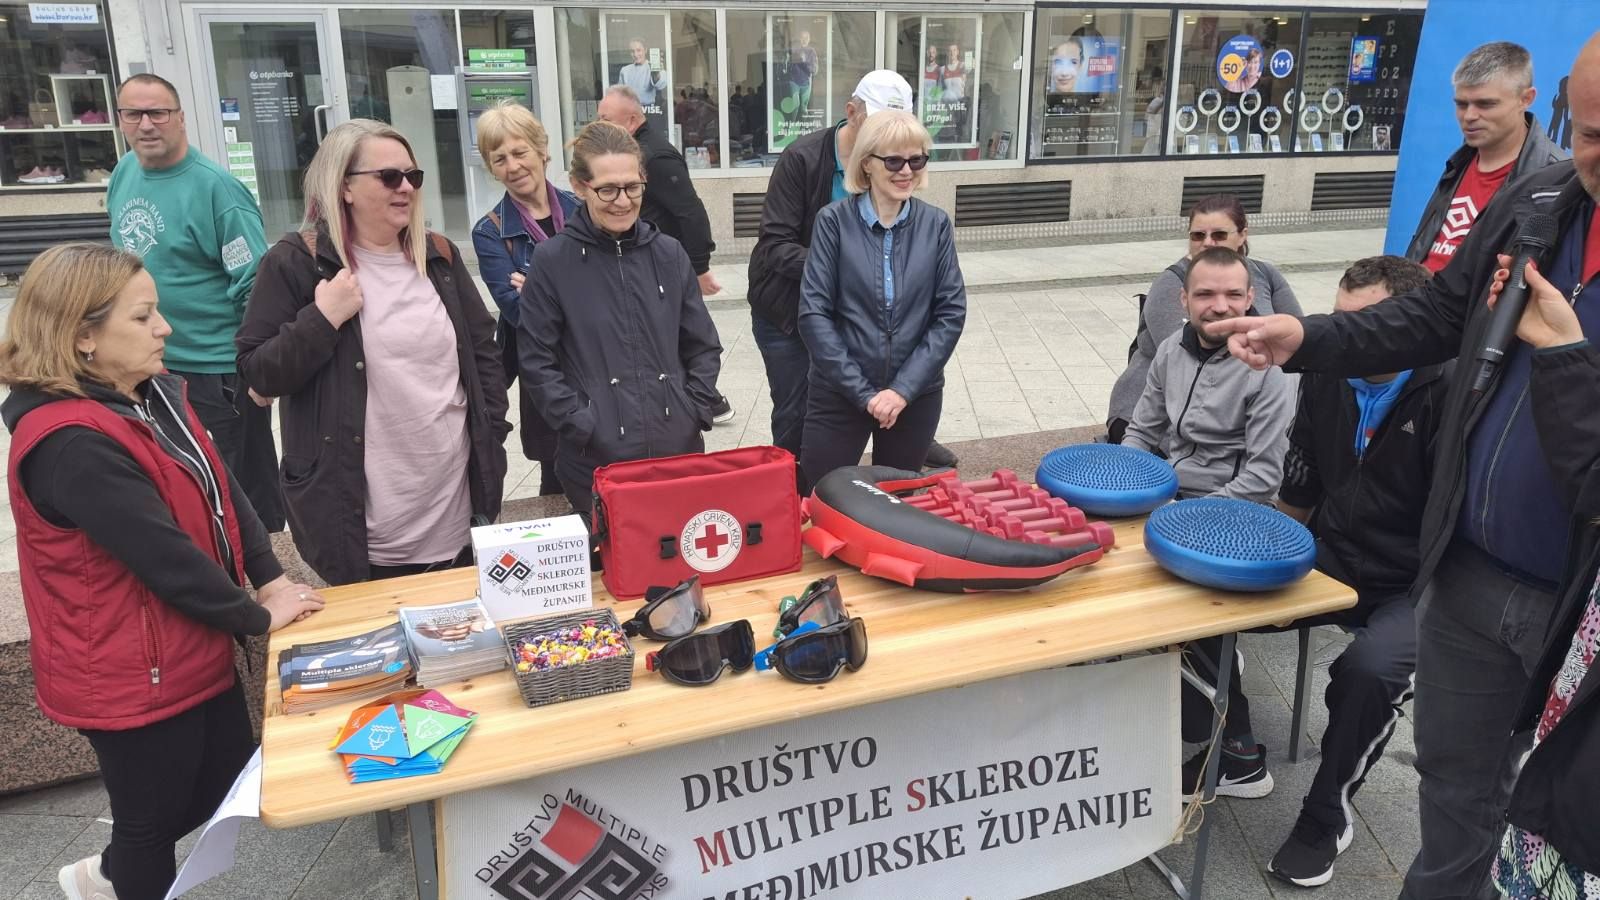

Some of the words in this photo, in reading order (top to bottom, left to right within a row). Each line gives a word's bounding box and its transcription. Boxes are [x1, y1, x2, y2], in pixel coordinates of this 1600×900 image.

[1273, 58, 1291, 69] 1+1
[259, 70, 294, 80] otpbanka
[641, 104, 663, 114] VIŠE,
[948, 101, 967, 111] VIŠE,
[149, 204, 166, 233] BAND
[683, 517, 702, 558] HRVATSKI
[703, 512, 735, 528] CRVENI
[537, 539, 584, 553] DRUŠTVO
[538, 553, 585, 566] MULTIPLE
[537, 567, 585, 581] SKLEROZE
[521, 581, 586, 597] MEĐIMURSKE
[543, 593, 587, 608] ŽUPANIJE
[680, 736, 877, 813] DRUŠTVO
[693, 786, 893, 875] MULTIPLE
[906, 746, 1100, 813] SKLEROZE
[977, 787, 1153, 851] ŽUPANIJE
[475, 793, 559, 884] DRUŠTVO
[564, 787, 668, 863] MULTIPLE
